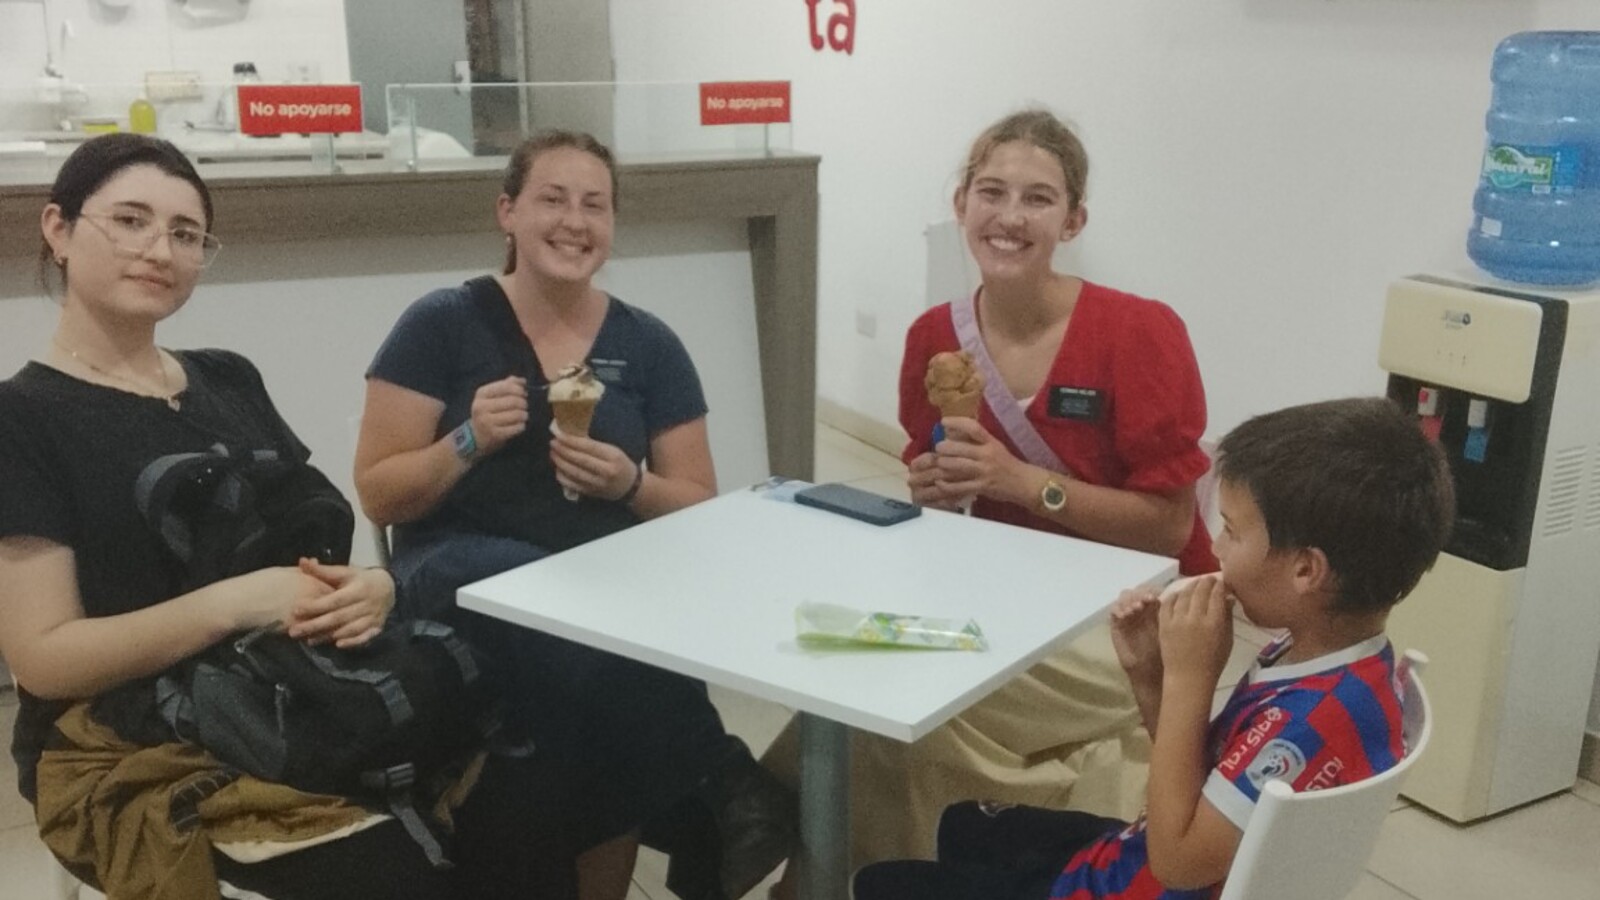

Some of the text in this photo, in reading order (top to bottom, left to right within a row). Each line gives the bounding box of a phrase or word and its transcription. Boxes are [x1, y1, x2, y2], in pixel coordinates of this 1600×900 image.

[249, 101, 352, 119] No apoyarse
[706, 96, 784, 111] No apoyarse
